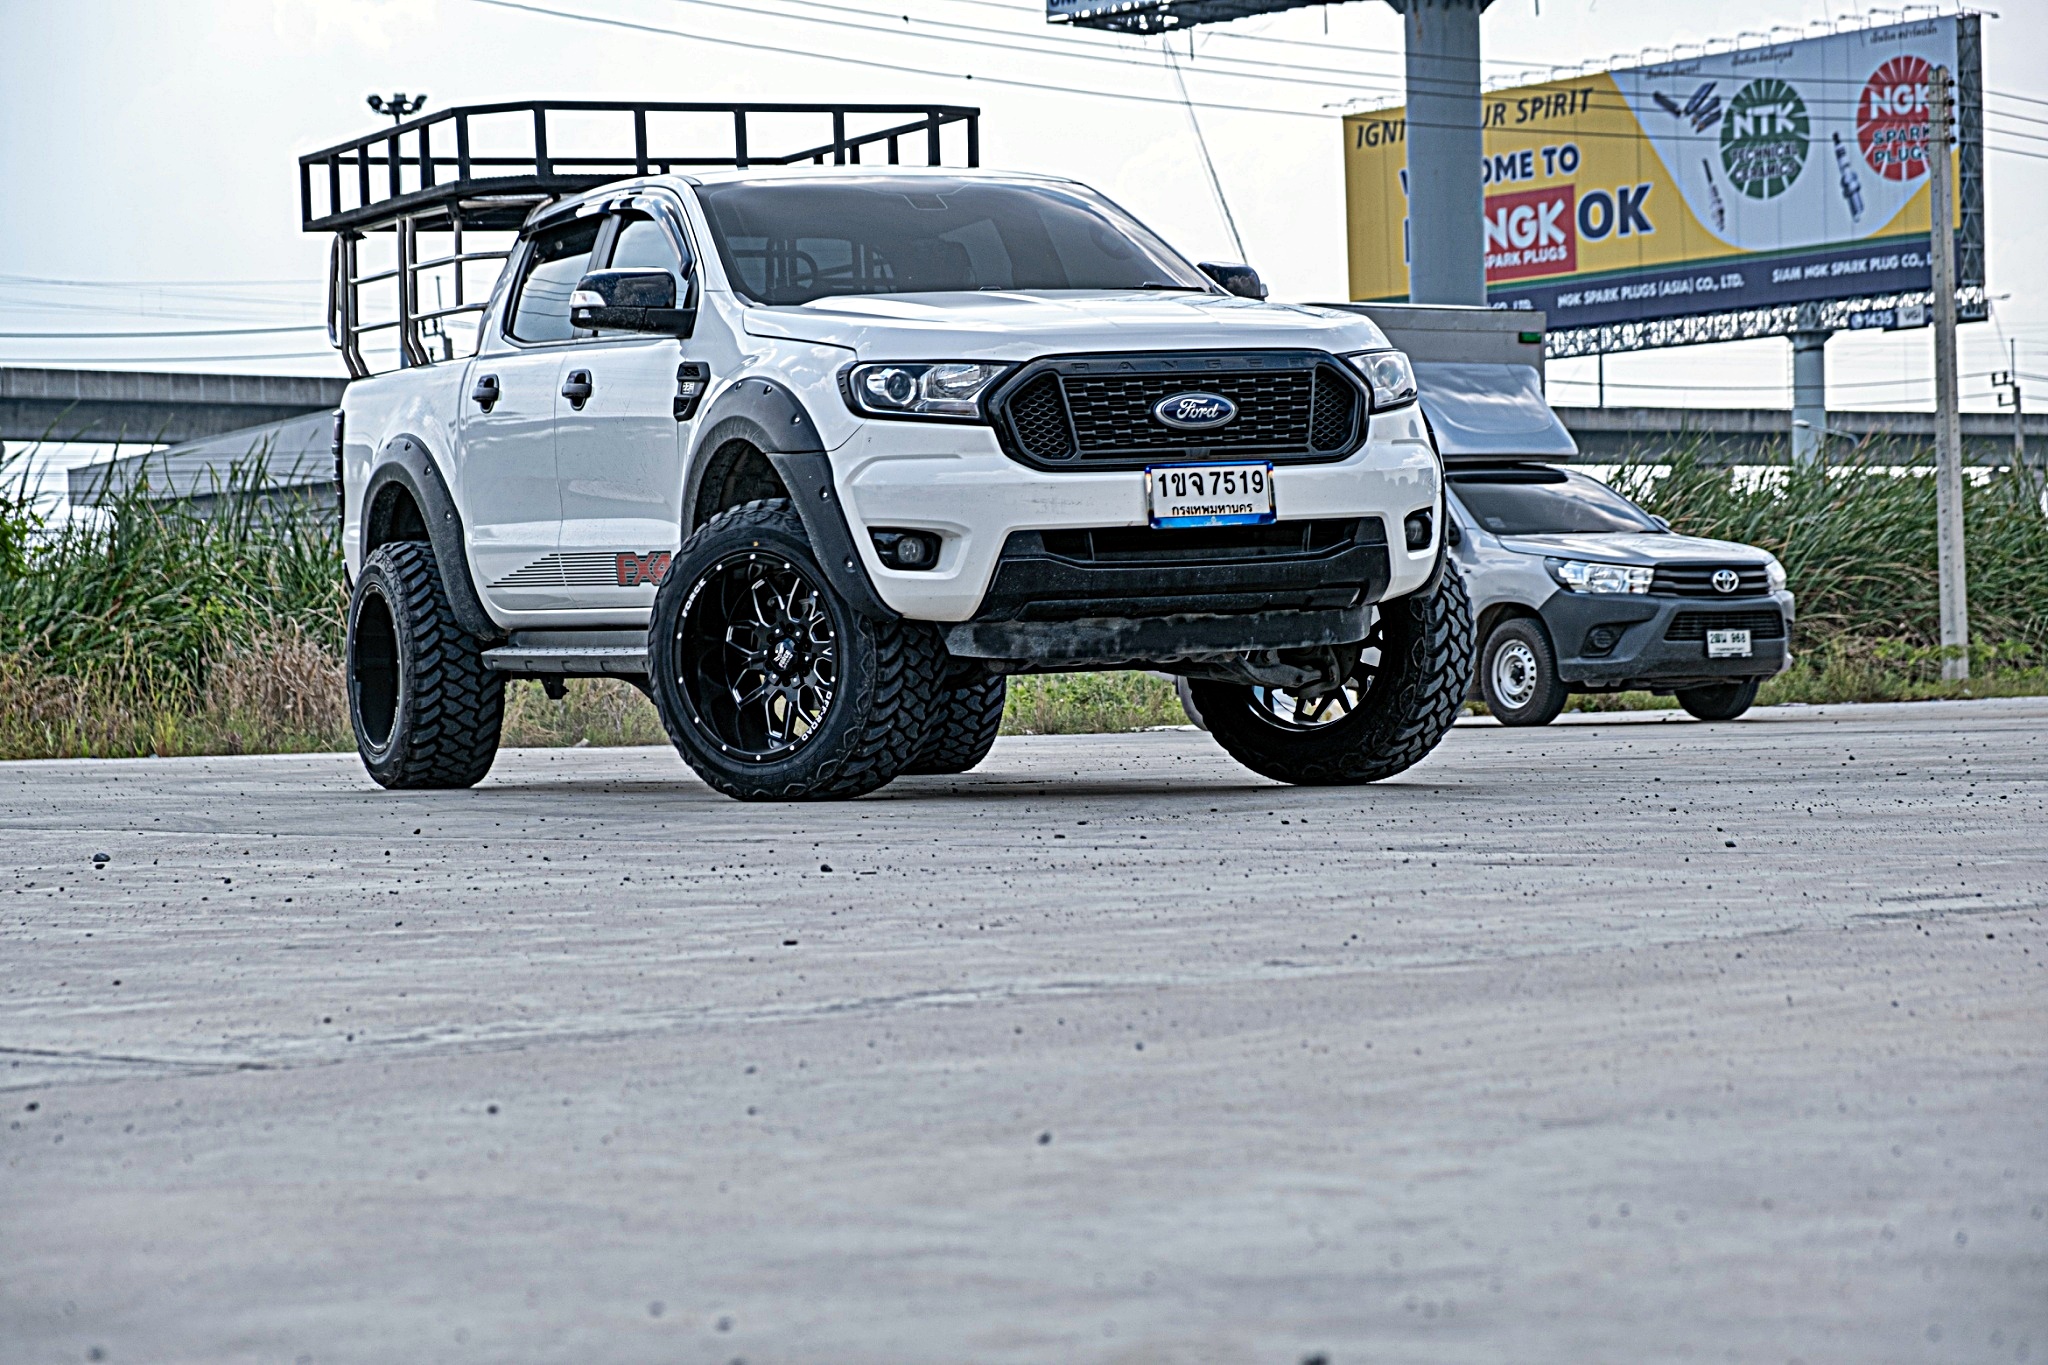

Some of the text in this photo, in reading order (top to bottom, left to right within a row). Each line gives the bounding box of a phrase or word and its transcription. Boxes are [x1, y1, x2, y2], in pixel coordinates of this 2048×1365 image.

[1357, 118, 1405, 149] IGNI
[1515, 87, 1593, 124] SPIRIT
[1870, 83, 1930, 119] NGK
[1733, 102, 1796, 139] NTK
[1542, 146, 1579, 176] TO
[1484, 184, 1654, 252] NGK OK
[1523, 245, 1568, 264] PLUGS
[1772, 266, 1802, 283] SIAM
[1804, 263, 1830, 279] NGK
[1831, 259, 1868, 277] SPARK
[1869, 254, 1898, 272] PLUG
[1557, 292, 1582, 309] NGK
[1583, 287, 1620, 305] SPARK
[1621, 282, 1657, 301] PLUGS
[1658, 277, 1694, 298] (ASIA)
[1720, 273, 1745, 290] LTD.
[1176, 398, 1219, 419] Ford
[1158, 470, 1264, 497] 1ขจ 7519
[616, 551, 671, 586] FX4
[681, 577, 707, 618] FORCE
[801, 690, 833, 741] OFF-ROAD
